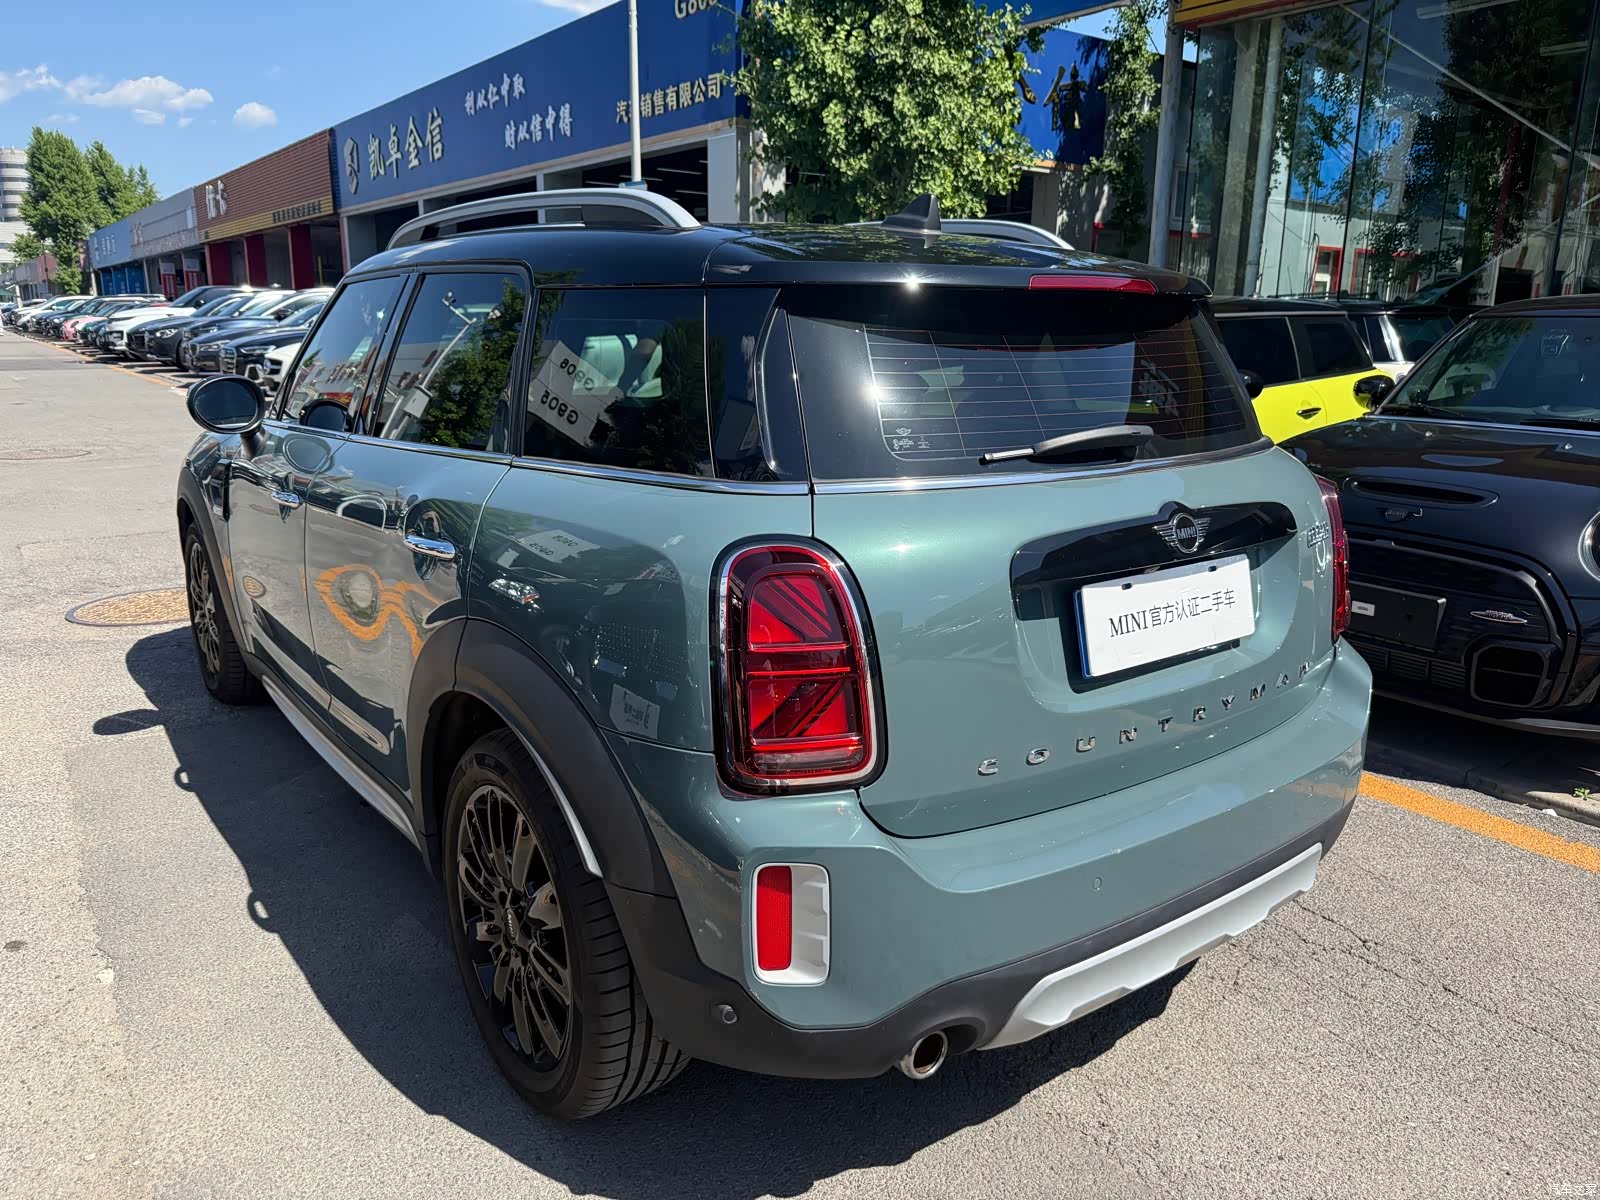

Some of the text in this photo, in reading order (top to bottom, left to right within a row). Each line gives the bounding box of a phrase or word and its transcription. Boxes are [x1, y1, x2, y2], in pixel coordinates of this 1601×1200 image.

[464, 72, 527, 117] 利从仁中取
[615, 72, 721, 124] 汽销售有限公司
[367, 106, 444, 182] 凯卓金信
[504, 102, 574, 150] 财从信中得
[1176, 528, 1198, 540] MINI
[977, 661, 1311, 776] COUNTRYMAN
